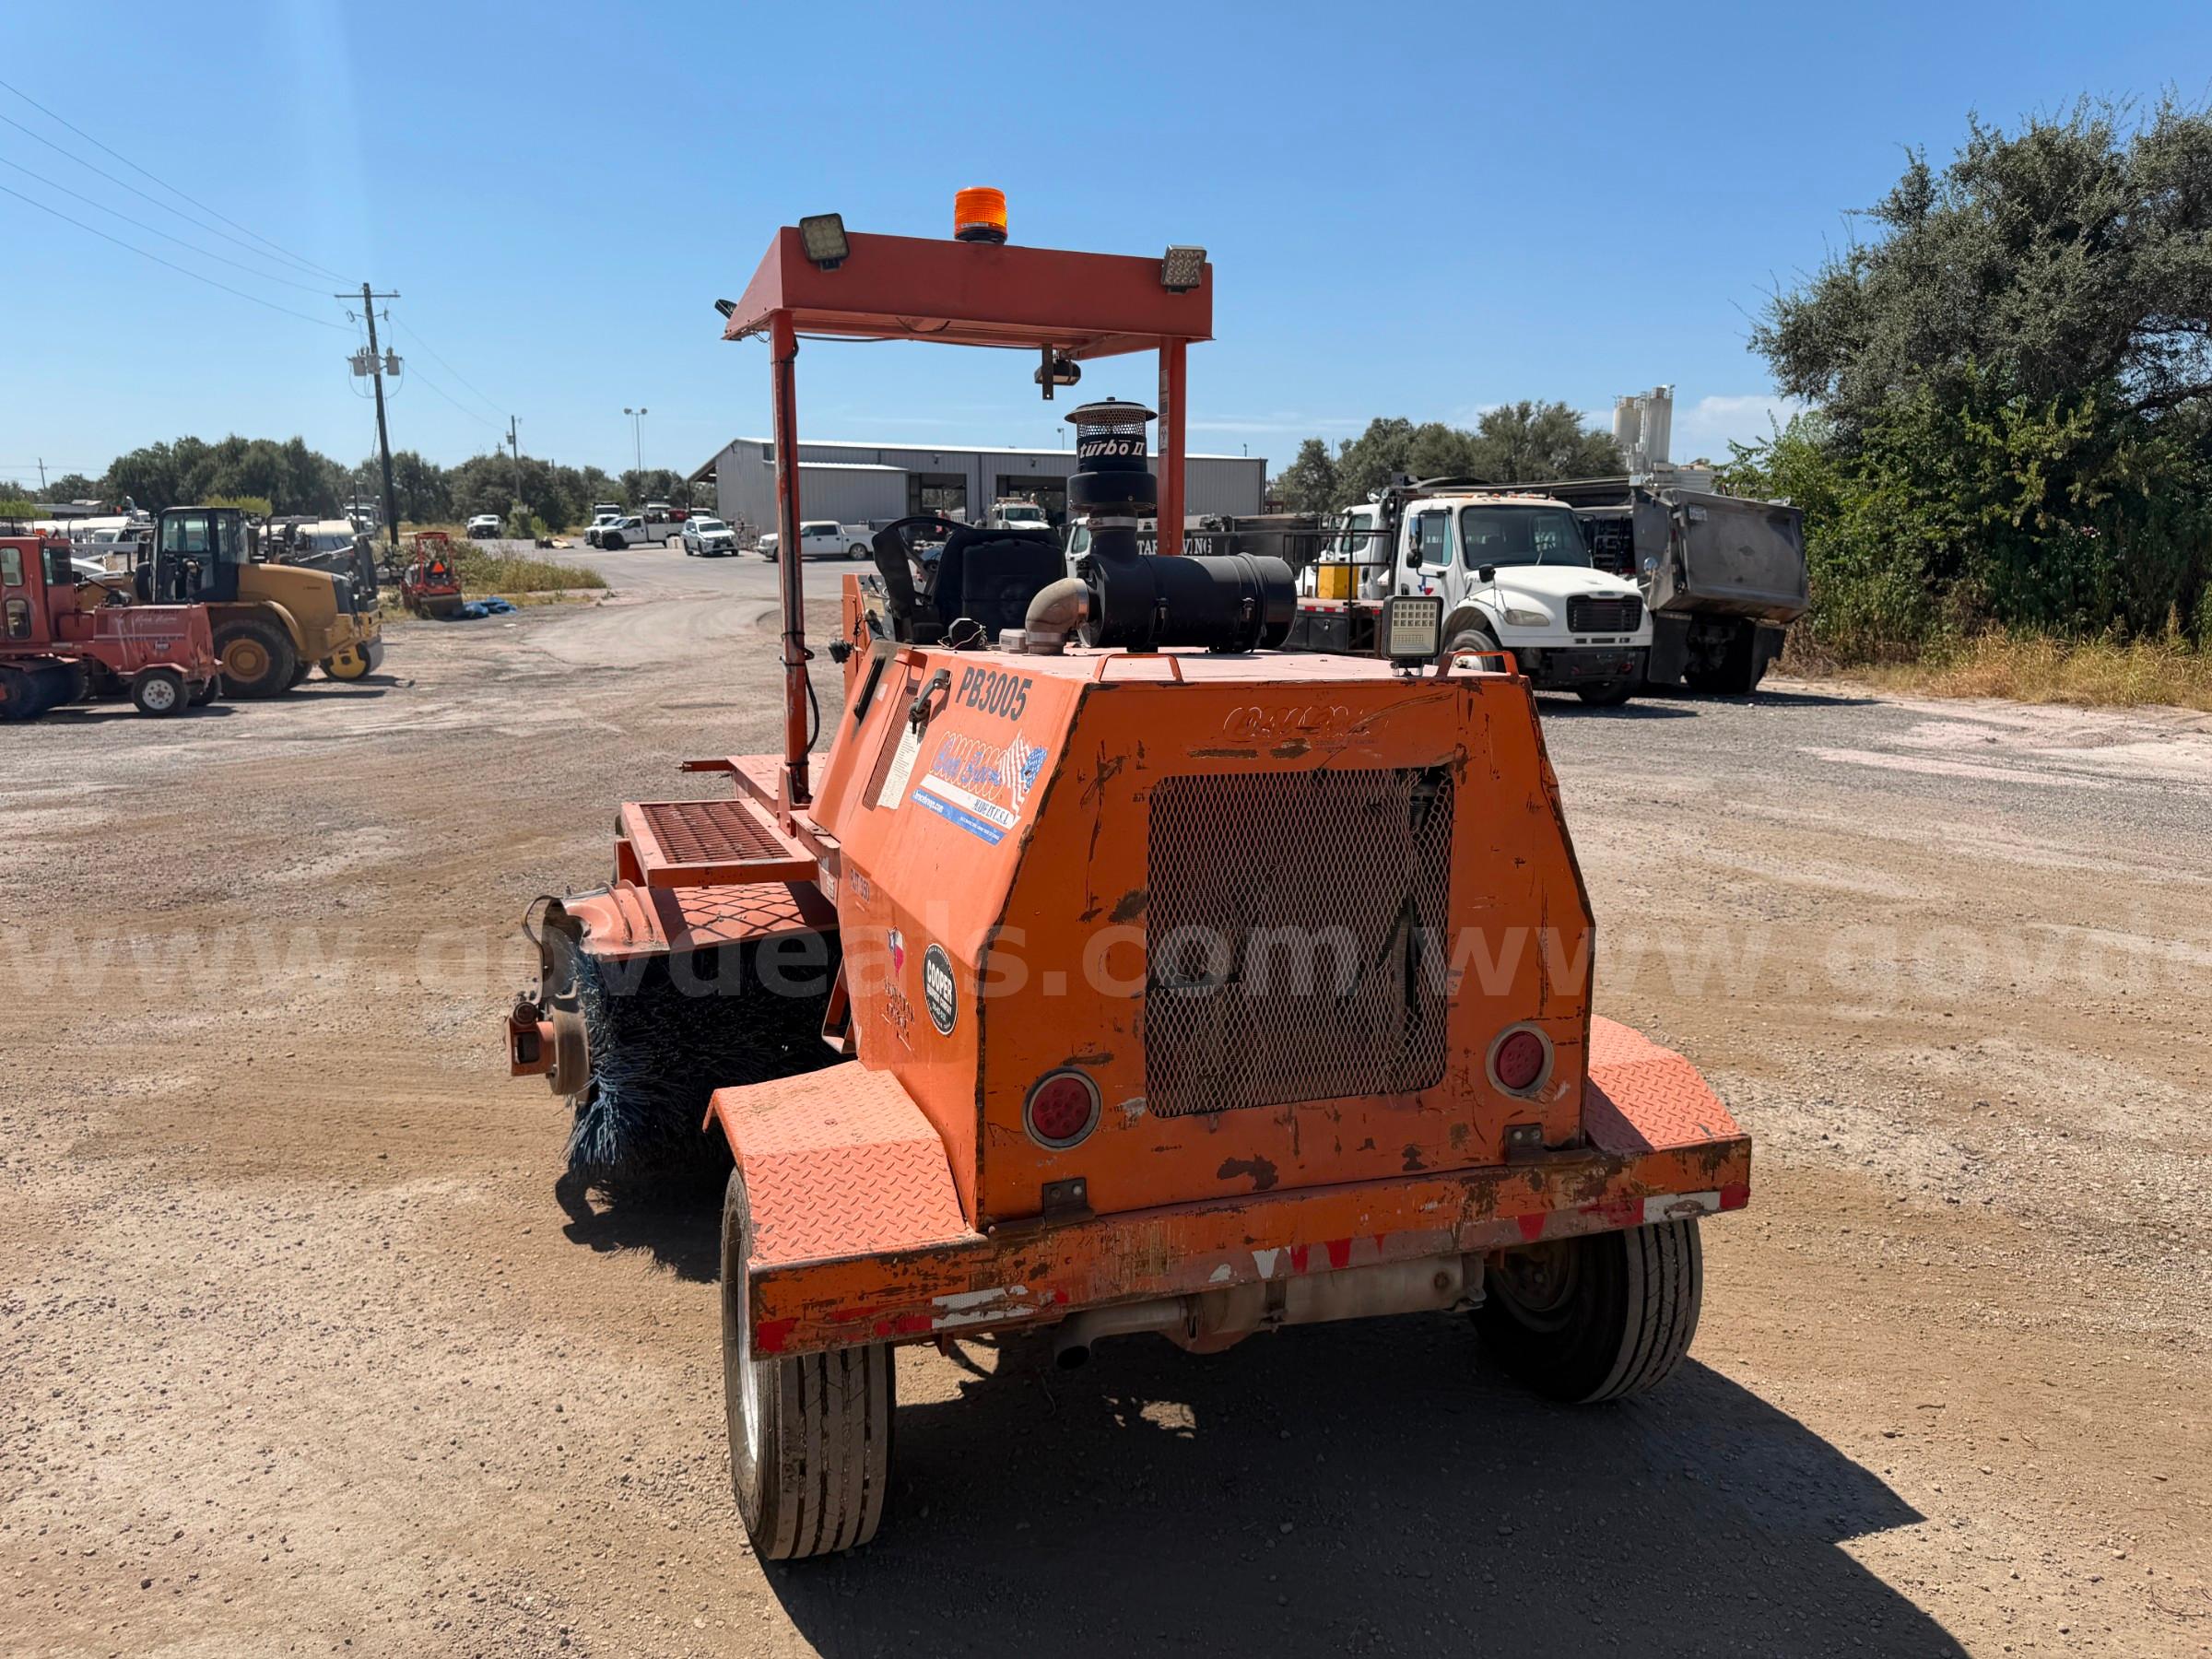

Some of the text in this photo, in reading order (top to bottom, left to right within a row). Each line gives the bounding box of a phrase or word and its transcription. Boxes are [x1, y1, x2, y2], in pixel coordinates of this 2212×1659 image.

[1079, 439, 1130, 459] turbo
[1181, 537, 1212, 555] VING
[955, 665, 1033, 722] PB3005
[927, 959, 952, 1005] COOPER
